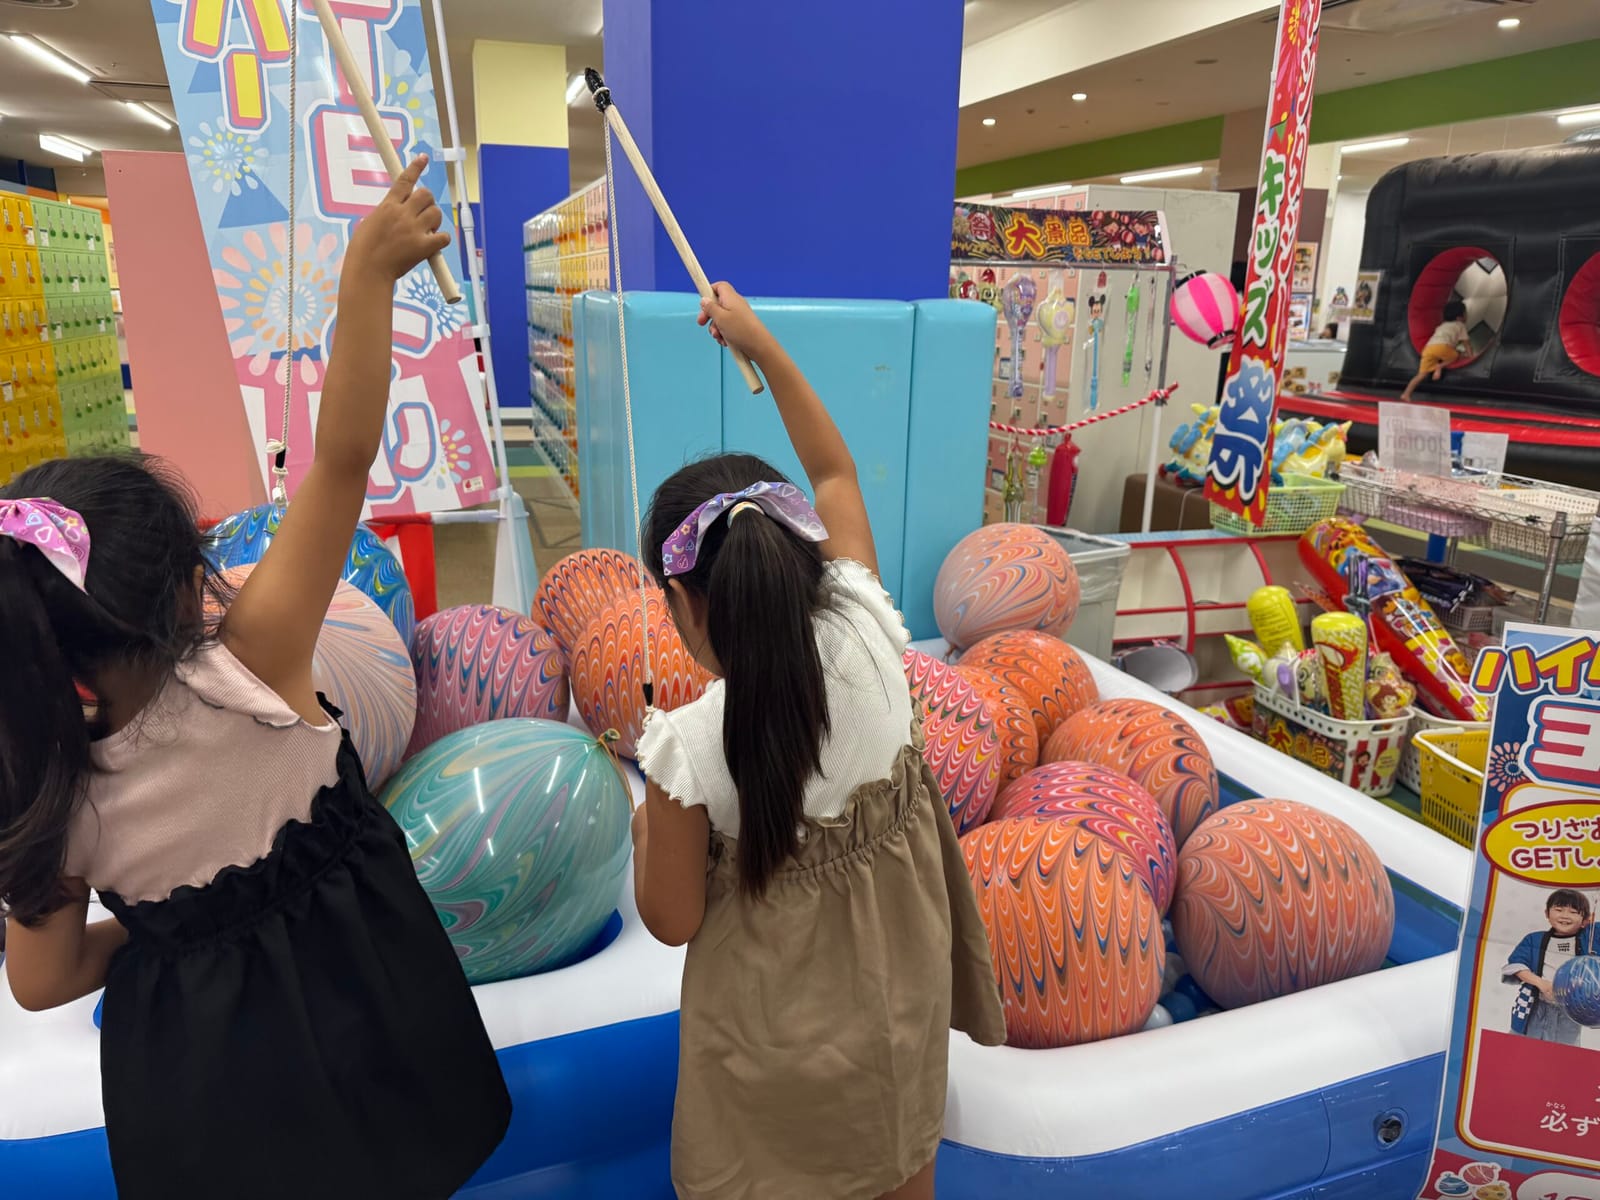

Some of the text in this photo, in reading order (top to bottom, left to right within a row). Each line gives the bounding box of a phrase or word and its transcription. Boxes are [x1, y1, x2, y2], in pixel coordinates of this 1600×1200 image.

[1268, 722, 1331, 769] 大品
[1510, 846, 1600, 869] GETし
[1540, 1109, 1600, 1137] 必ず
